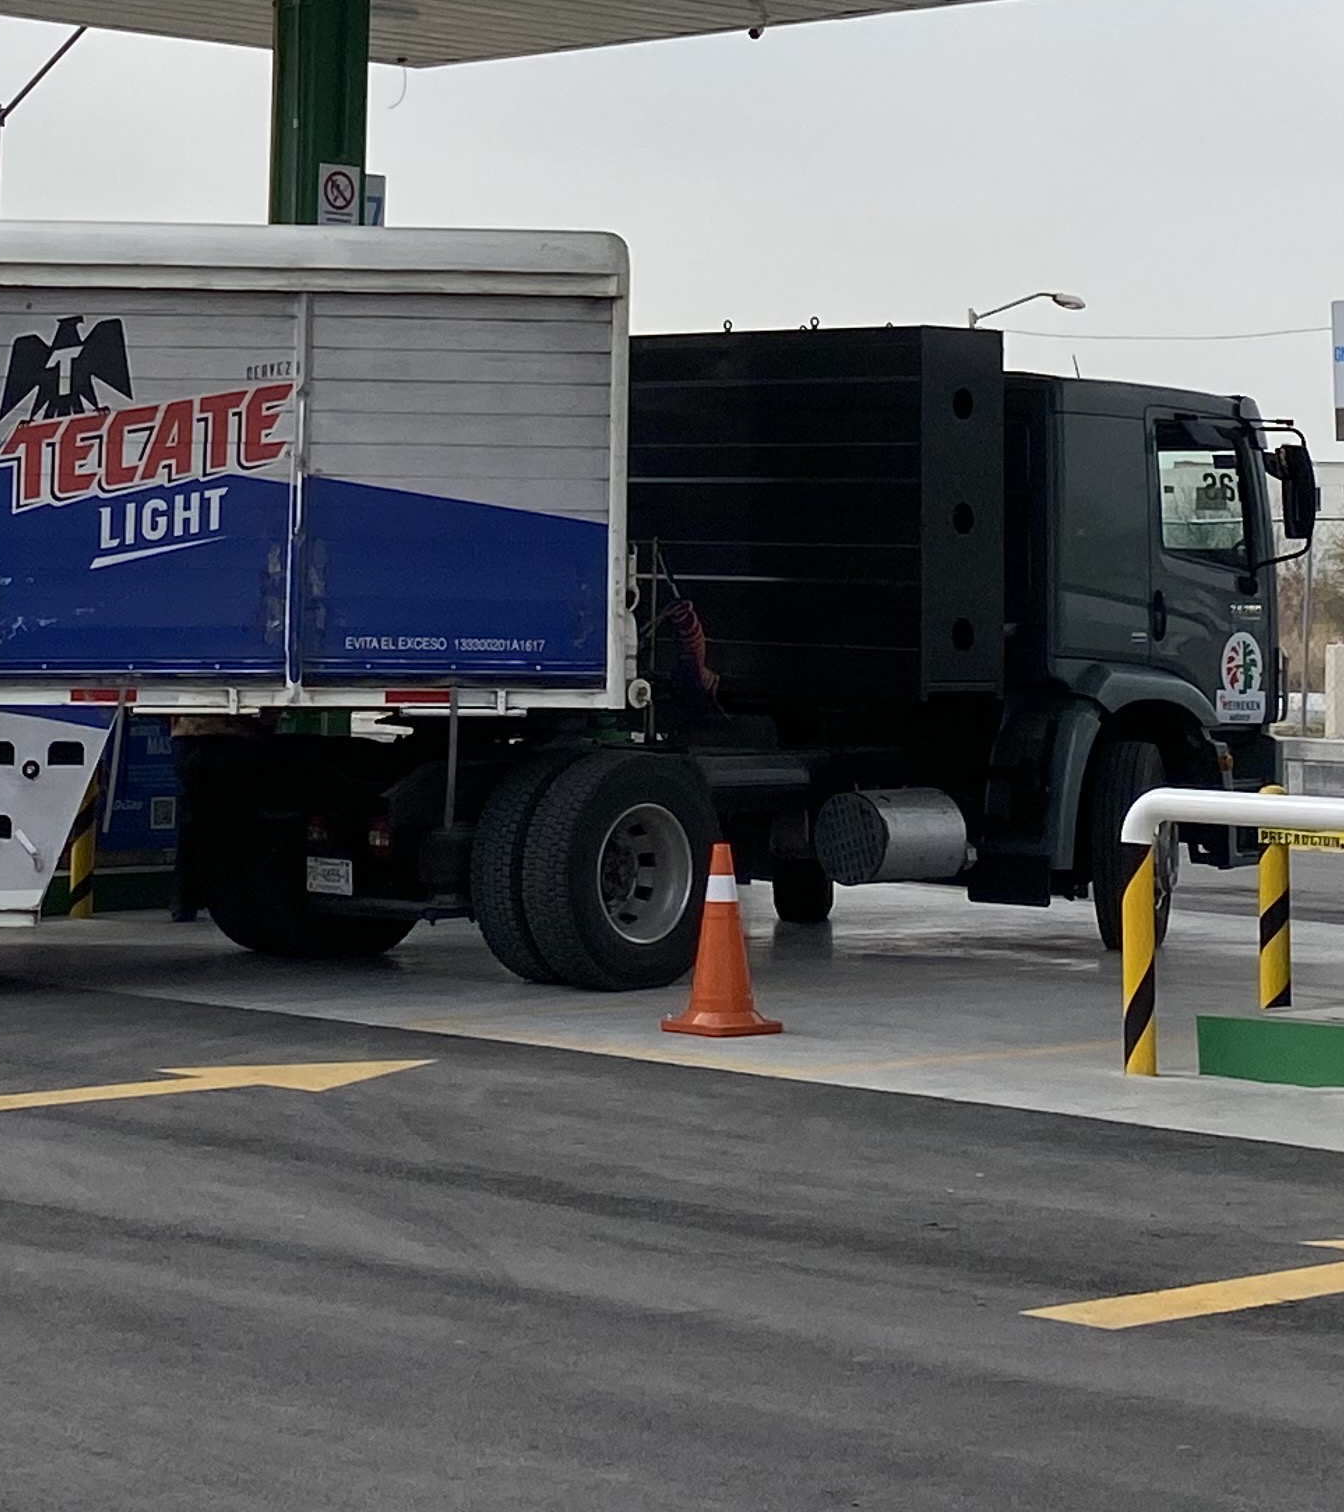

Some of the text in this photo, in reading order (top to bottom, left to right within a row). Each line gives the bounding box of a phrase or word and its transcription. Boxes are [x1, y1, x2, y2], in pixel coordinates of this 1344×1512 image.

[100, 487, 228, 549] LIGHT
[345, 637, 379, 650] EVITA
[381, 637, 395, 650] EL
[398, 637, 447, 651] EXCESO
